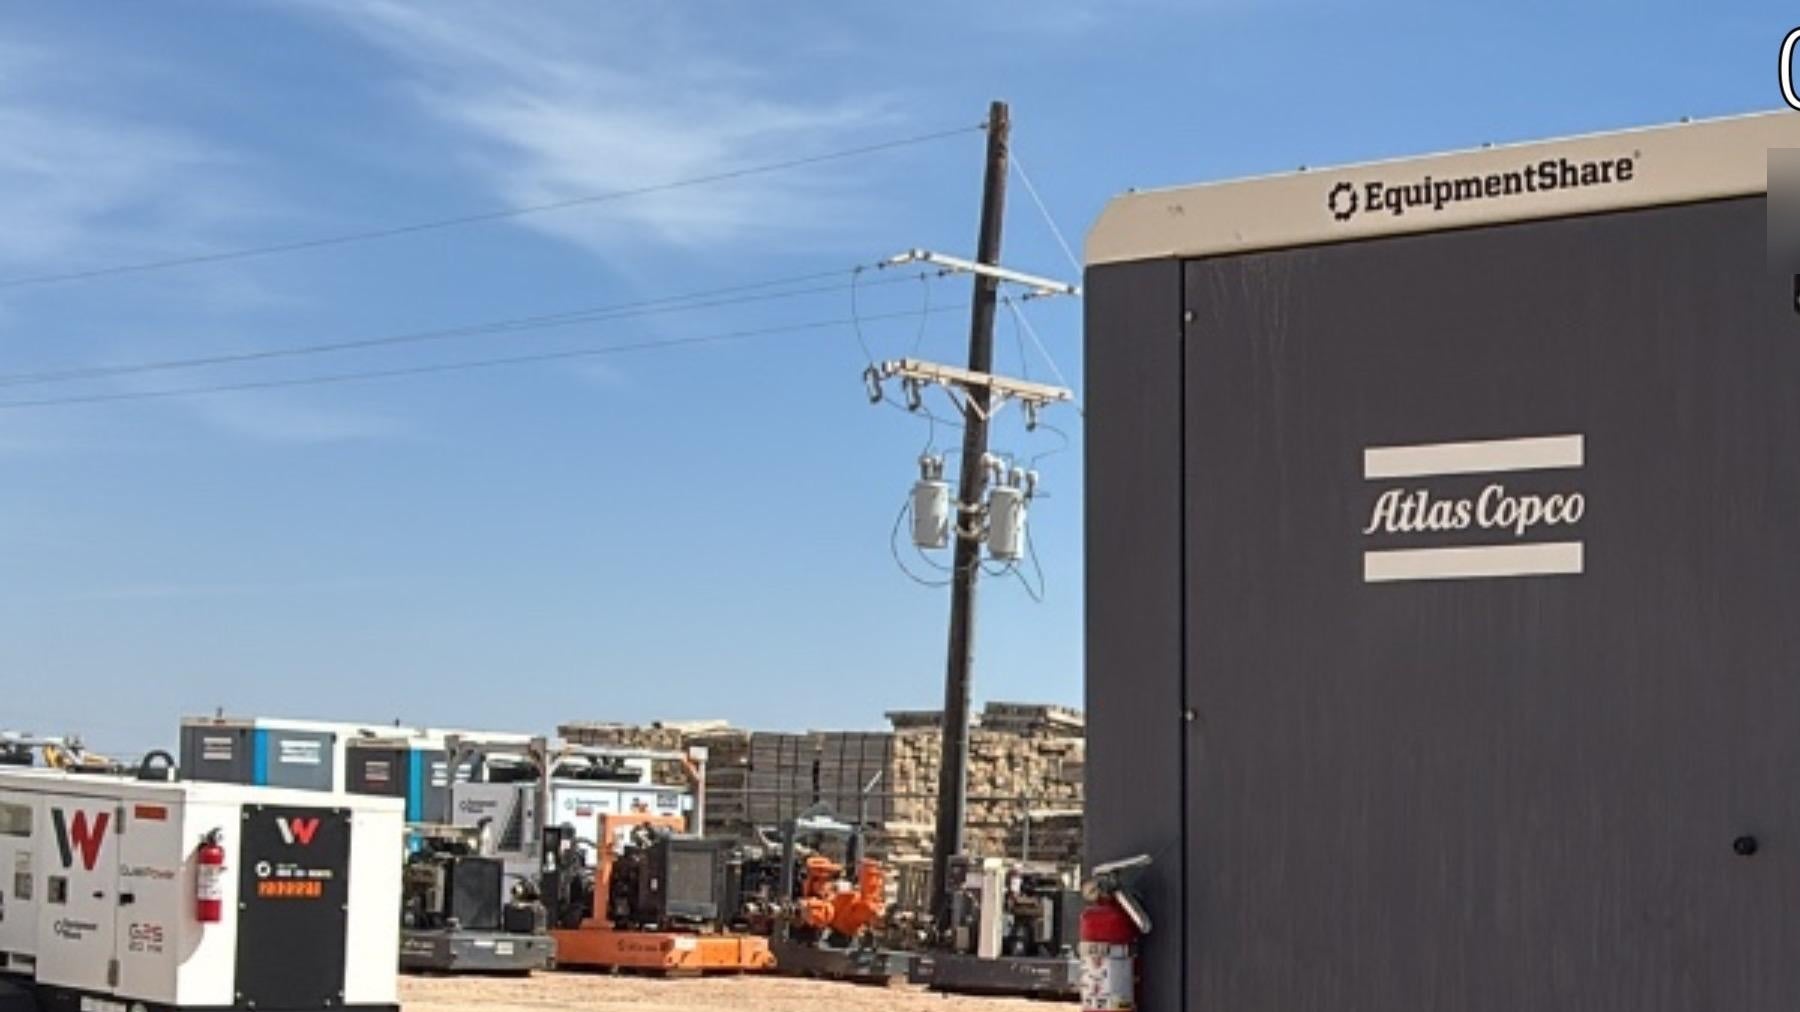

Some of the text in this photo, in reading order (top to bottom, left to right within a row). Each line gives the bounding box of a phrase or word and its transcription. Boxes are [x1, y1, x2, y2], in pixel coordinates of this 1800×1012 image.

[1364, 156, 1634, 215] EquipmentShare
[1363, 484, 1585, 536] Atlas Copco
